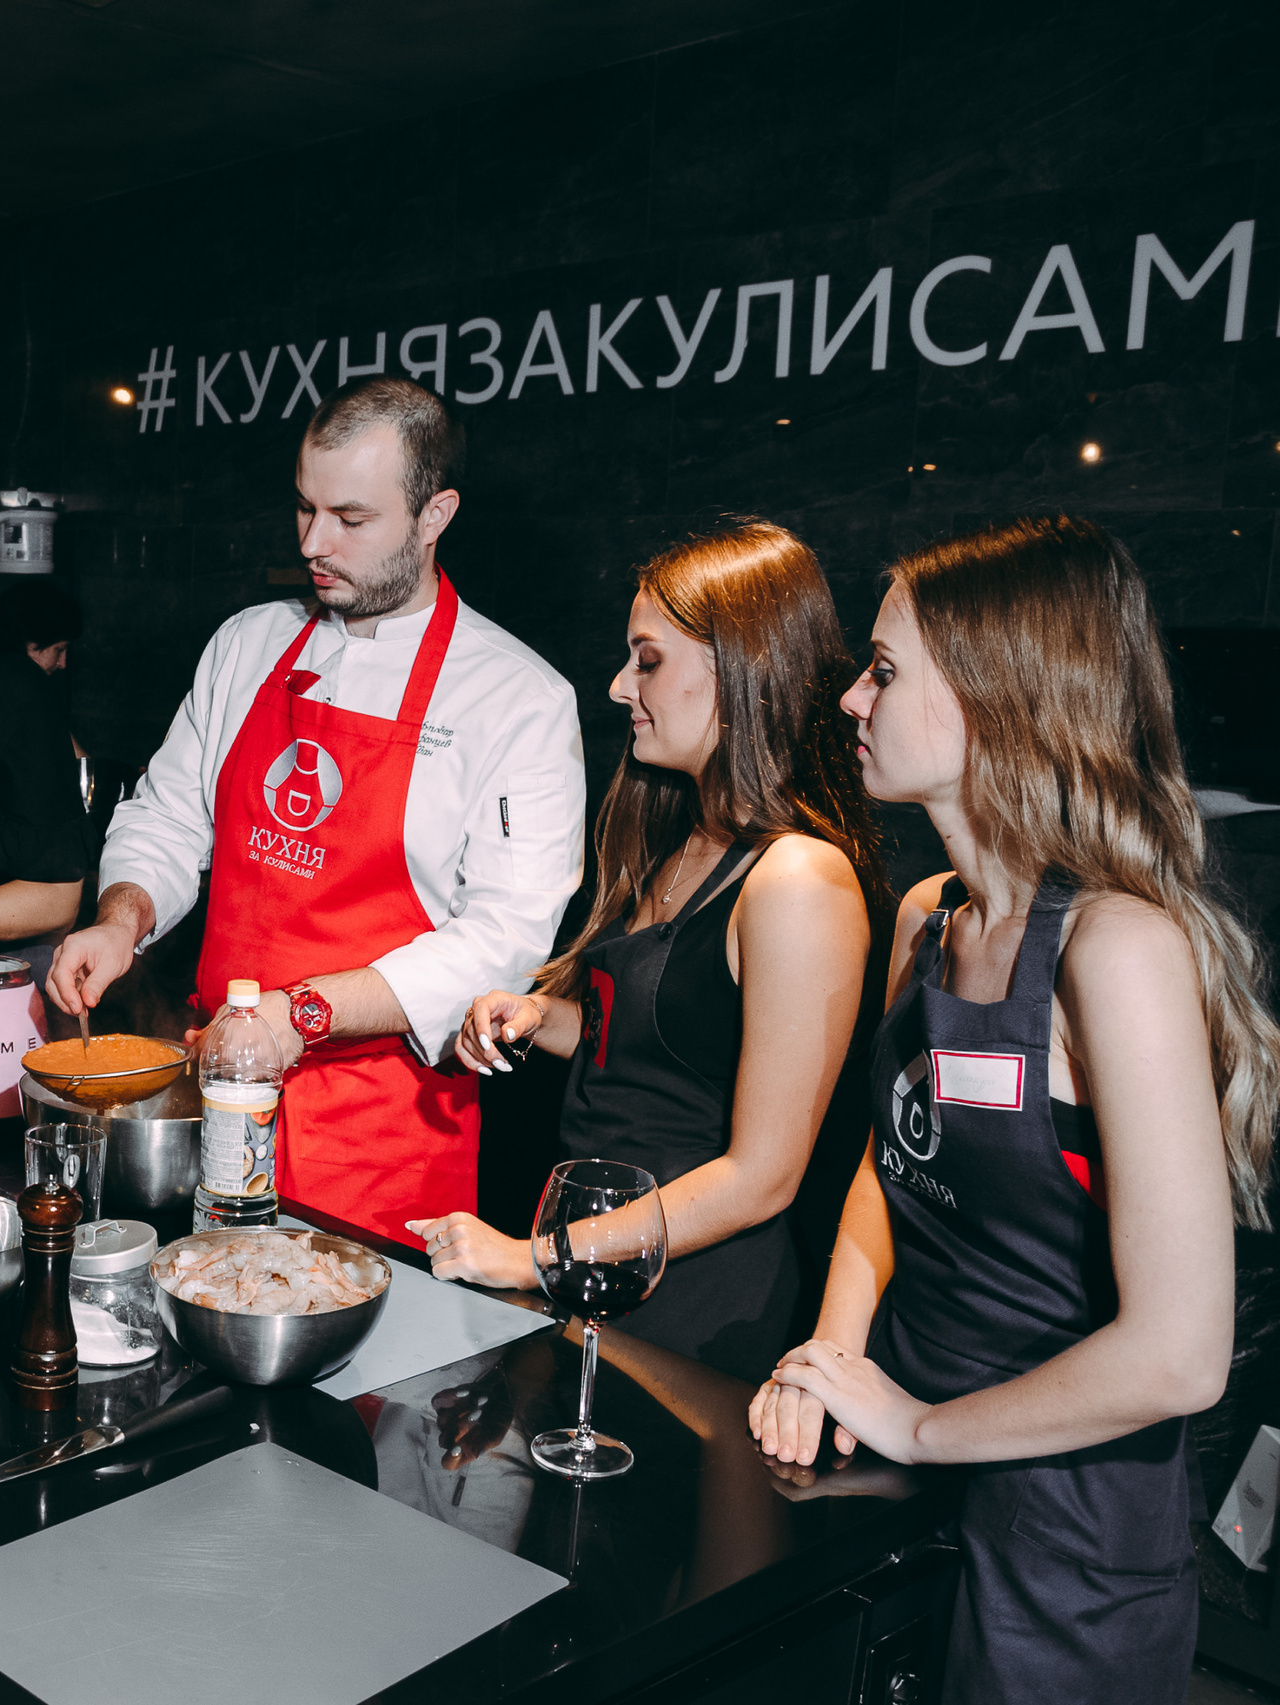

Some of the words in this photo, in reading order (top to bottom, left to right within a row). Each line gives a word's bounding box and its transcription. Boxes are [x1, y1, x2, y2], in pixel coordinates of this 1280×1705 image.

[136, 219, 1280, 434] #КУХНЯЗАКУЛИСАМ
[248, 825, 326, 870] КУХНЯ
[249, 850, 260, 861] ЗА
[263, 855, 316, 880] КУЛИСАМИ
[880, 1140, 958, 1209] КУХНЯ
